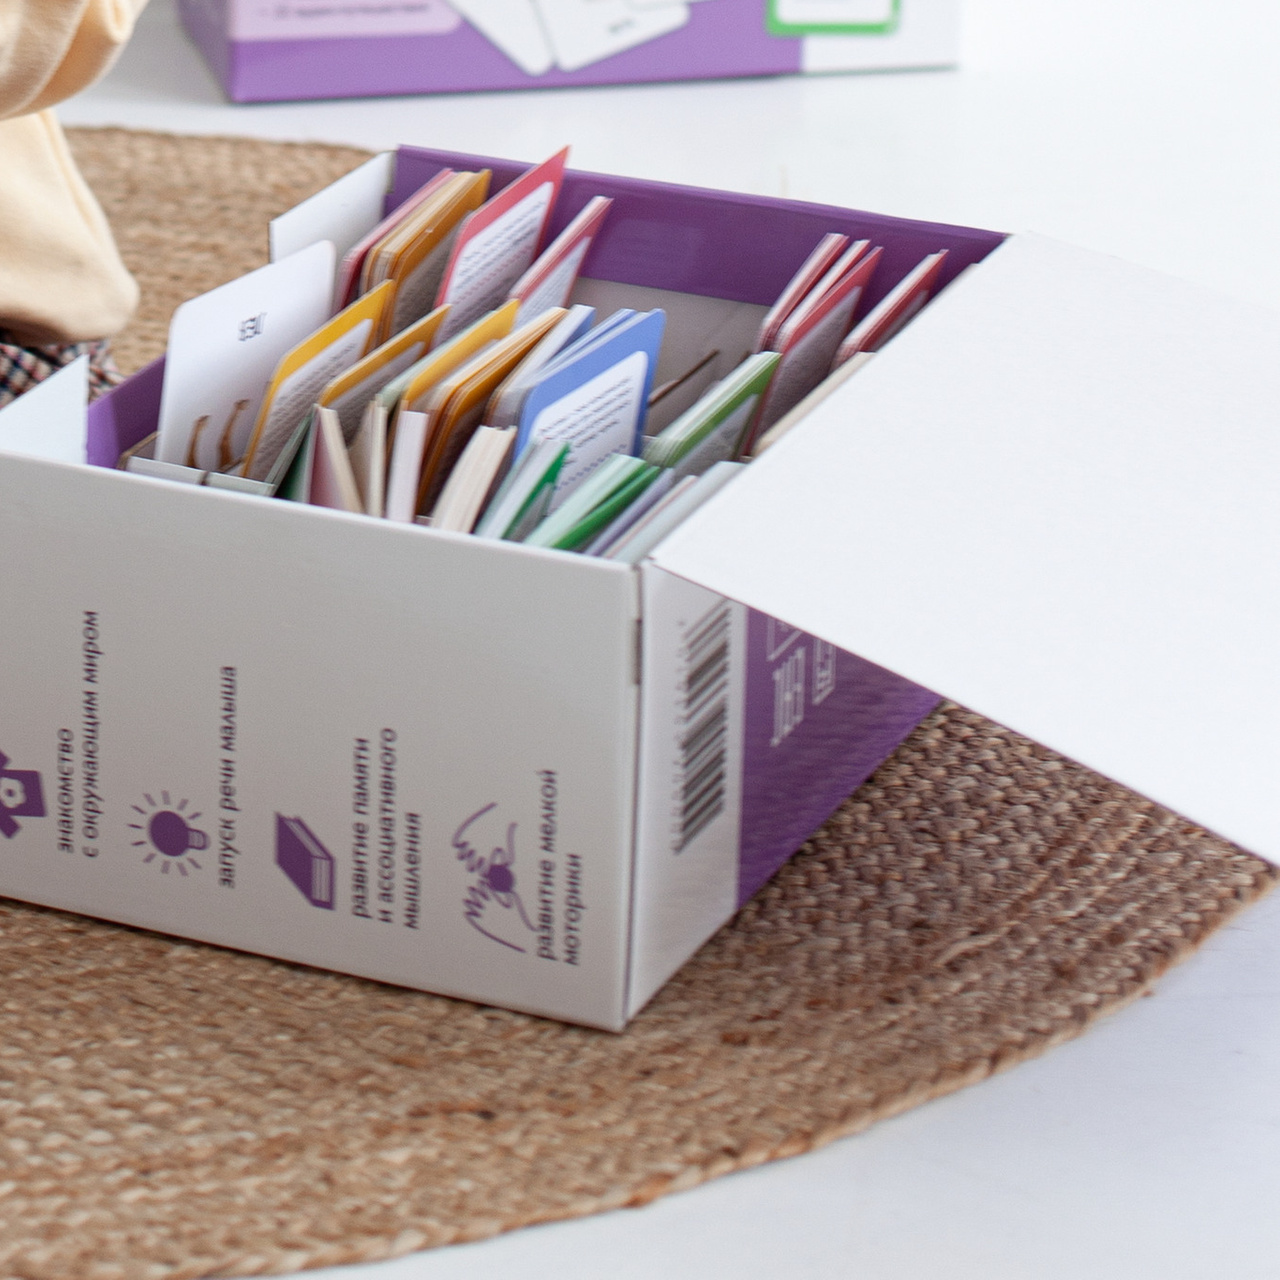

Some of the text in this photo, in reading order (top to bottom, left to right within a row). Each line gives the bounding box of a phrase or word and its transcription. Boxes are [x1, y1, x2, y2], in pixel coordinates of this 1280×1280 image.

[57, 728, 74, 854] знакомство
[82, 610, 105, 858] с окружающим миром
[219, 665, 242, 889] запуск речи малыша
[377, 727, 398, 924] и ассоциативного
[351, 738, 373, 920] развитие памяти
[403, 812, 421, 930] мышления
[536, 769, 560, 962] развитие мелкой
[562, 852, 588, 967] моторики
